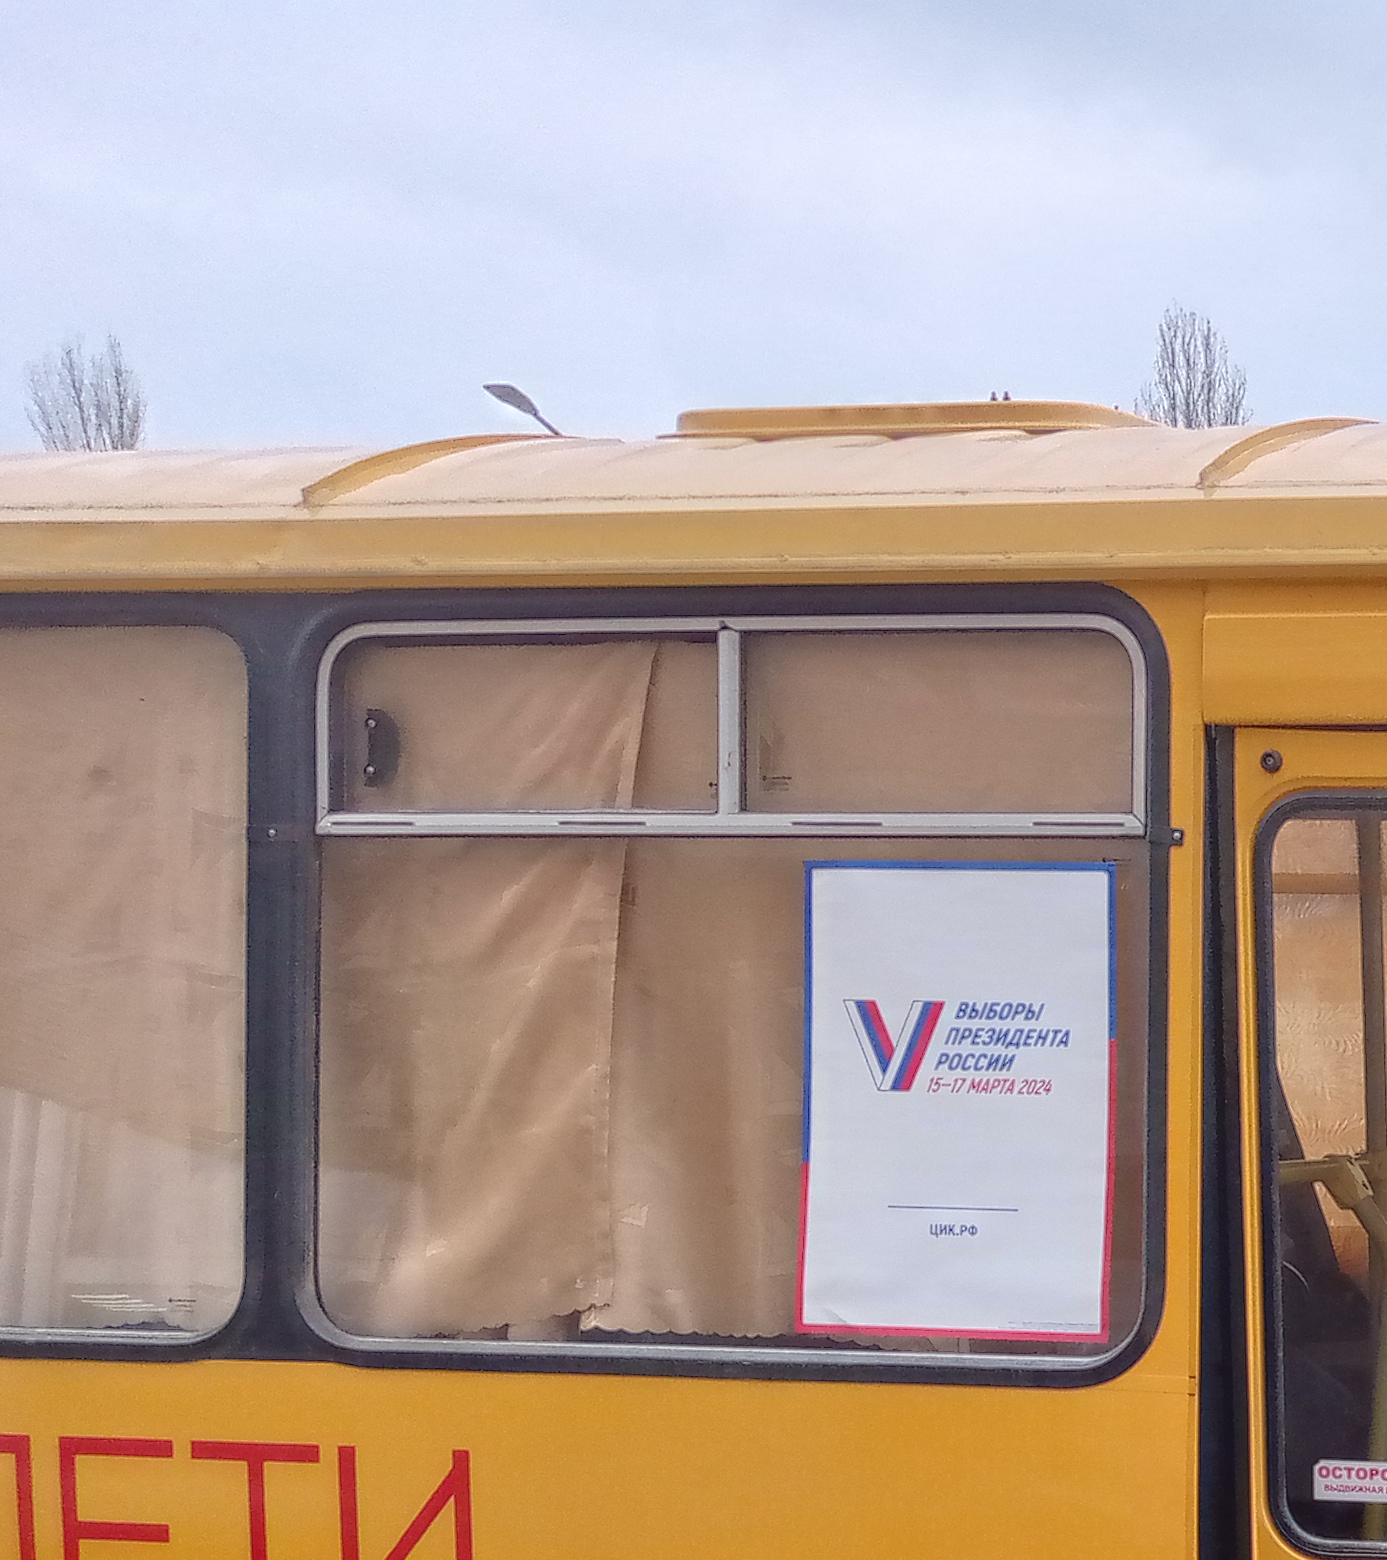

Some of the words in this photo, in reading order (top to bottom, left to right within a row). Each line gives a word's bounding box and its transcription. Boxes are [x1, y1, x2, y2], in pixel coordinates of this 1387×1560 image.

[954, 1001, 1045, 1021] ВЫБОРЫ
[944, 1027, 1071, 1050] ПРЕЗИДЕНТА
[934, 1053, 1016, 1072] РОССИИ
[967, 1078, 1015, 1094] МАРТА
[1017, 1079, 1052, 1095] 2024
[929, 1224, 978, 1238] ЦИК.РФ
[1324, 1484, 1383, 1495] ВЫДВИЖНАЯ
